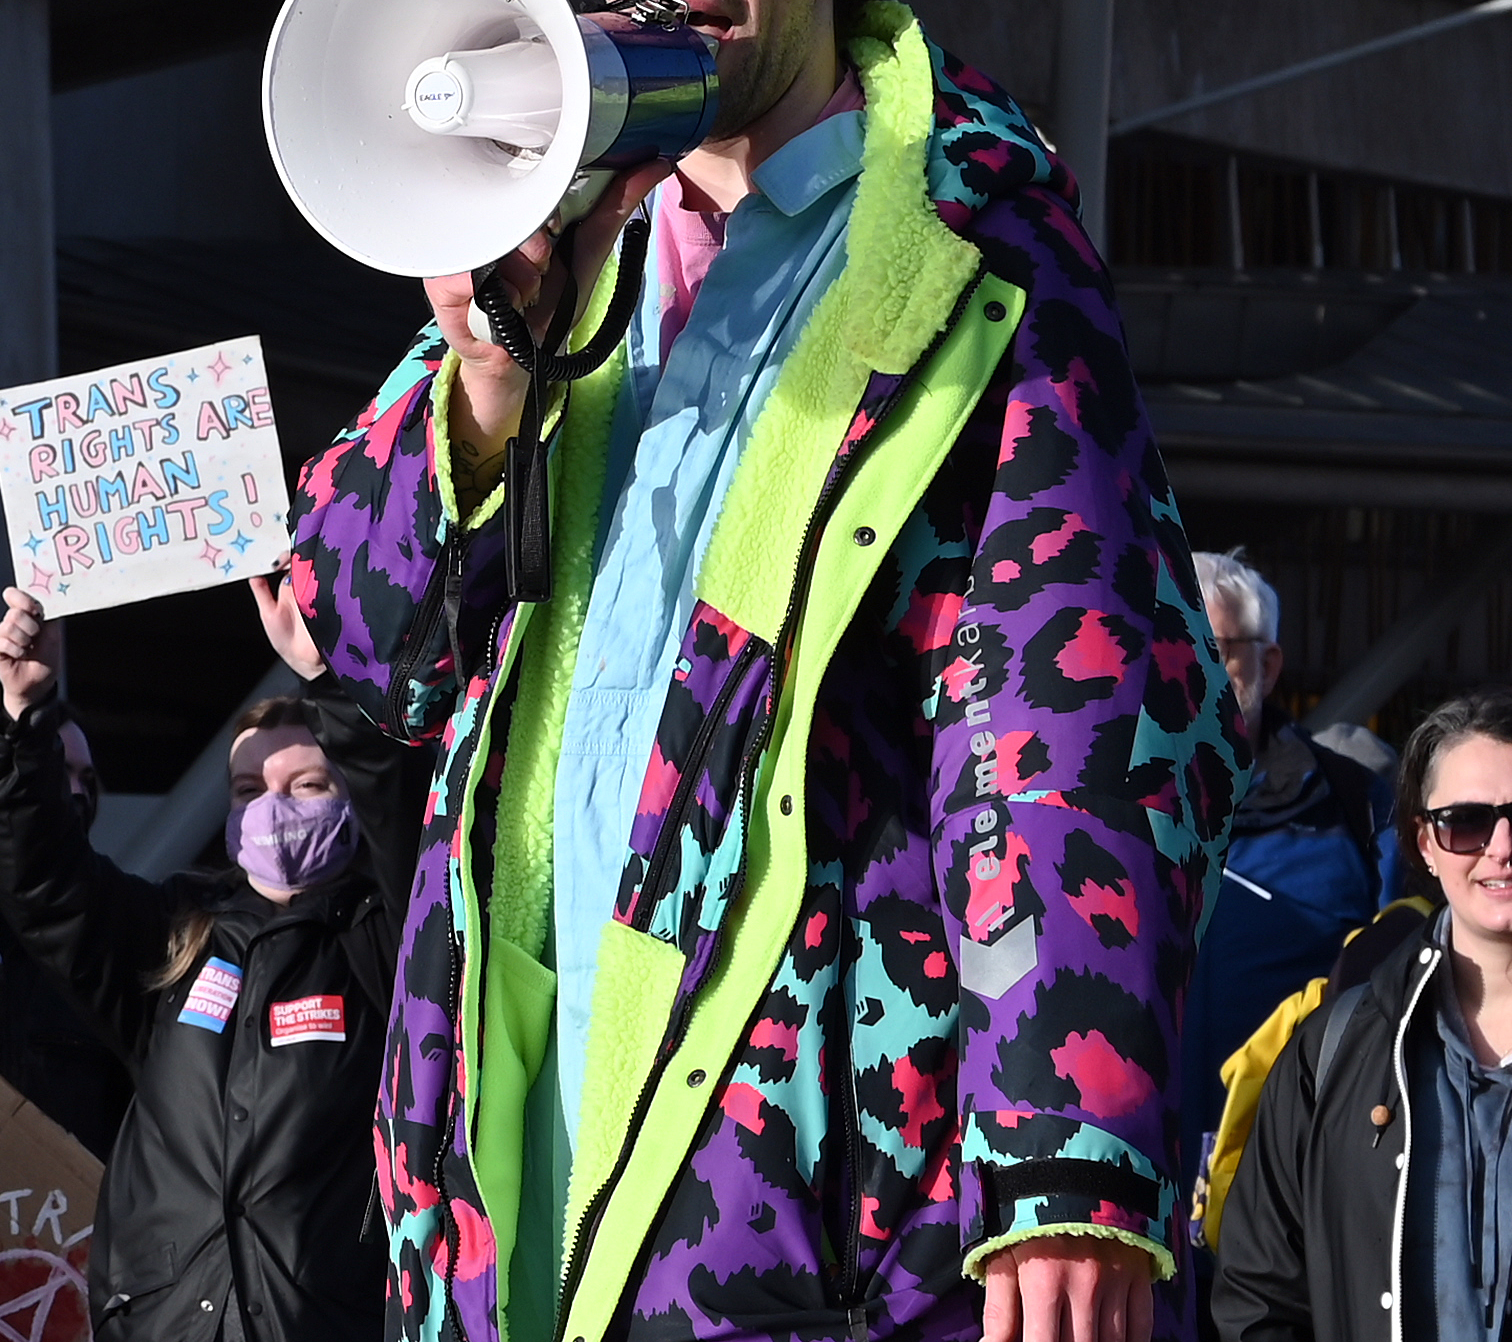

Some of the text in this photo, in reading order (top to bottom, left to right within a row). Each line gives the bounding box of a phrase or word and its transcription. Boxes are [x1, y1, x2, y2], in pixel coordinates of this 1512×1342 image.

[419, 93, 442, 102] EAGLE
[12, 367, 180, 440] TRANS
[28, 386, 274, 483] RIGHTS ARE
[35, 450, 201, 531] HUMAN
[199, 967, 240, 991] TRANS
[185, 997, 228, 1019] NOW!
[273, 997, 323, 1016] SUPPORT
[274, 1008, 341, 1026] THE STRIKES
